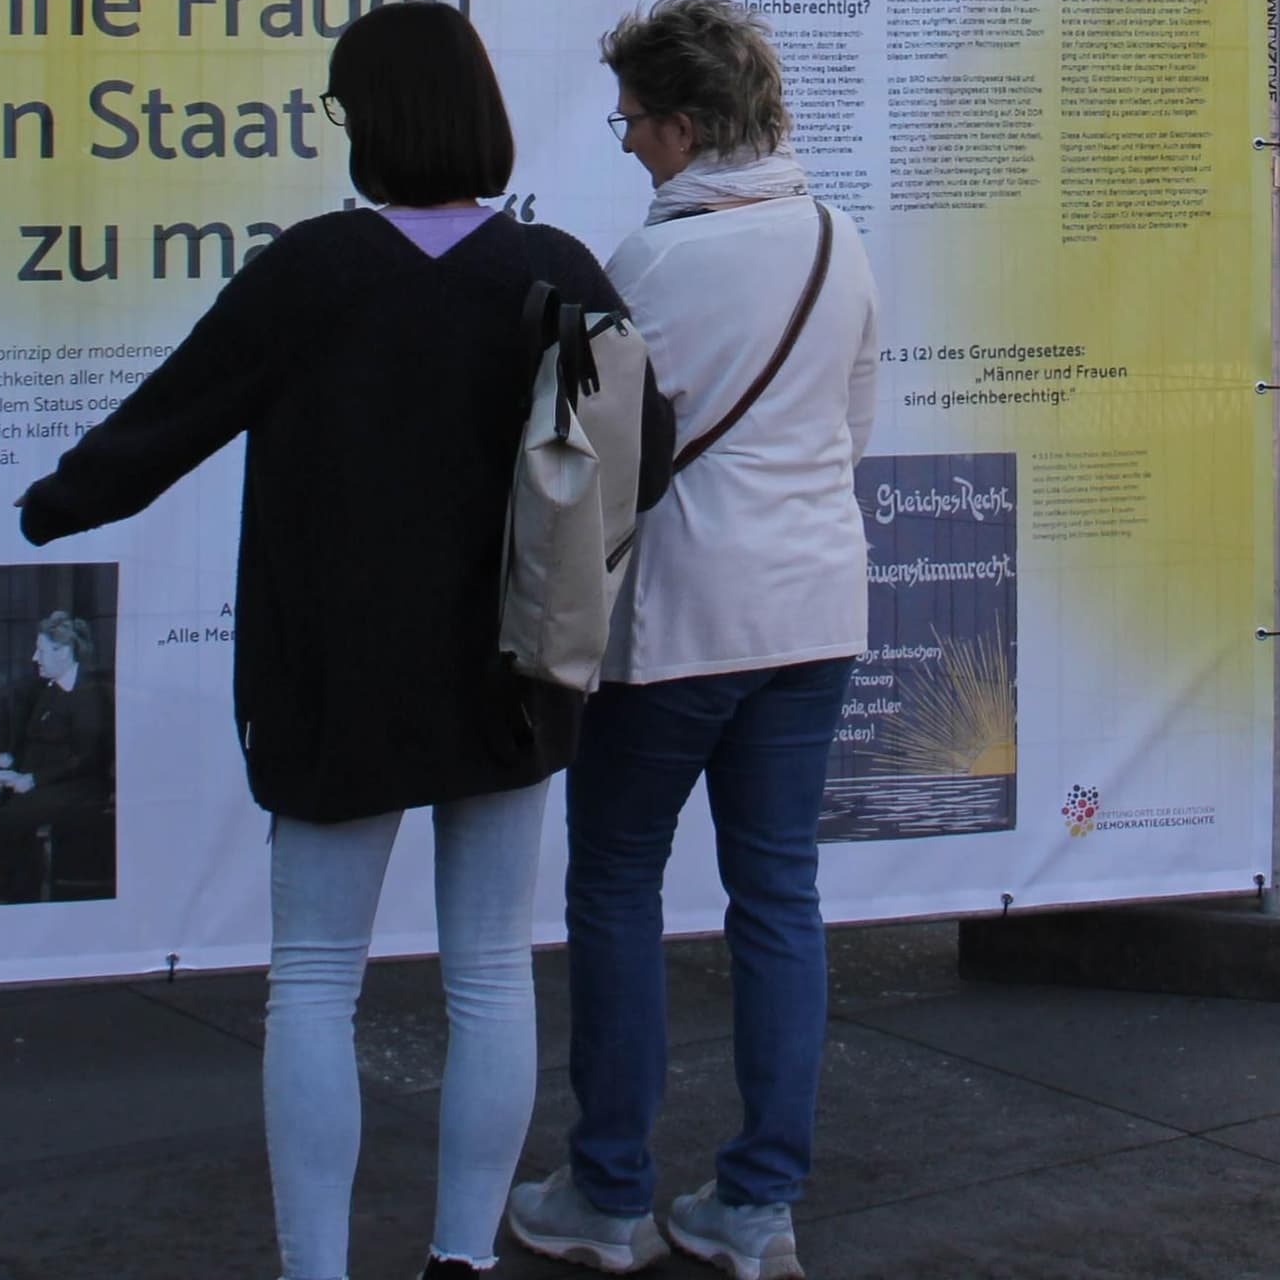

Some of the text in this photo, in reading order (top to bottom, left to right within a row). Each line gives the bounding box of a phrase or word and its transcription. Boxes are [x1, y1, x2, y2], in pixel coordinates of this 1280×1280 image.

[89, 79, 318, 161] Staat
[17, 224, 118, 282] zu
[58, 344, 83, 360] der
[88, 344, 175, 358] modernen
[899, 348, 909, 363] 3
[912, 345, 933, 363] (2)
[937, 344, 966, 360] des
[969, 342, 1086, 363] Grundgesetzes:
[70, 371, 104, 386] aller
[974, 363, 1128, 385] „Männer und Frauen
[34, 396, 83, 413] Status
[87, 396, 121, 410] ode
[904, 390, 937, 407] sind
[27, 422, 70, 439] klafft
[876, 483, 961, 524] Gleiches
[953, 476, 1013, 521] Recht,
[867, 553, 1016, 589] auenstimmrecht.
[157, 627, 200, 647] „Alle
[867, 697, 902, 714] aller
[1096, 815, 1216, 831] DEMOKRATIEGESCHICHTE
